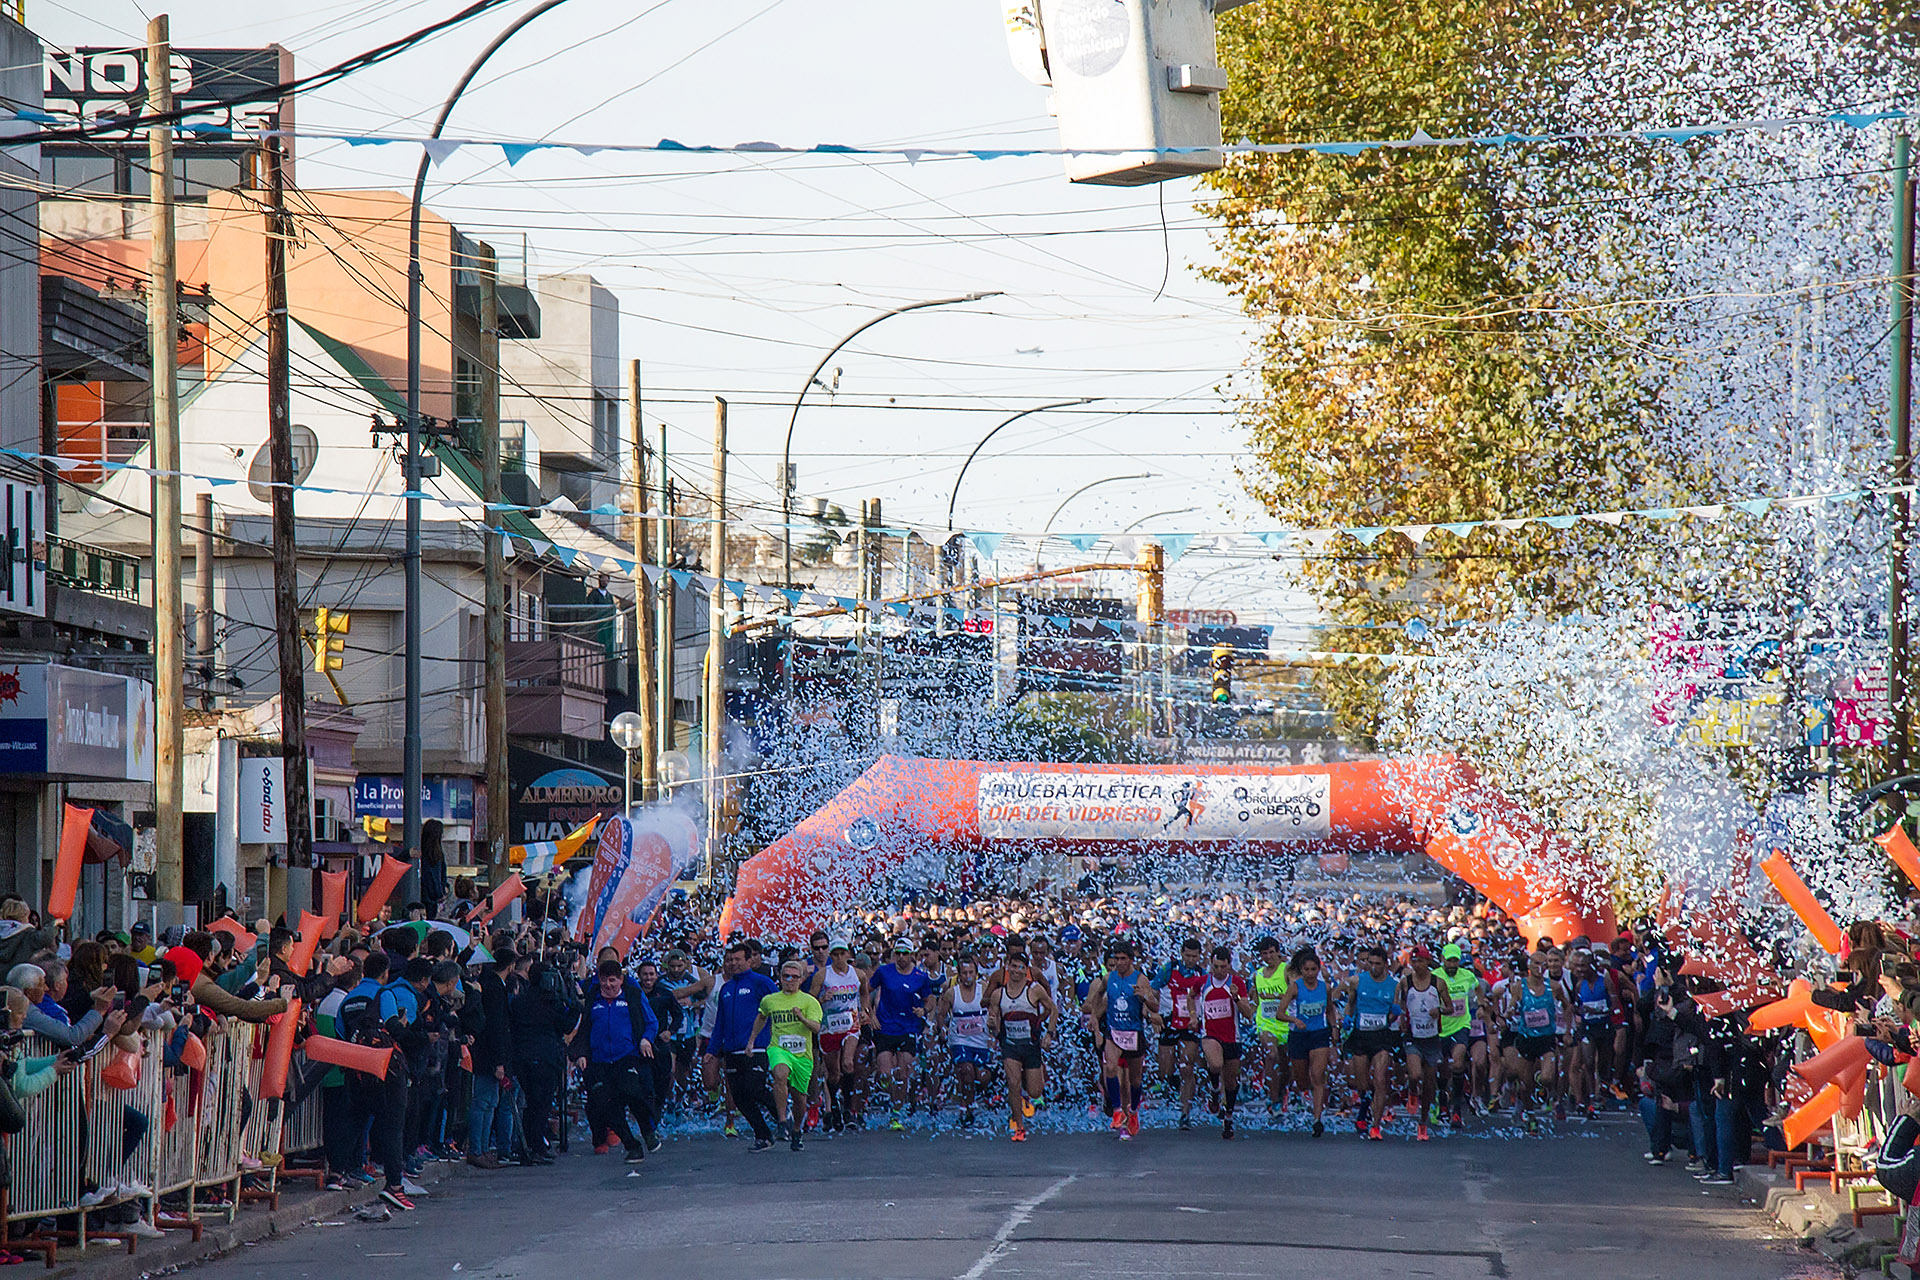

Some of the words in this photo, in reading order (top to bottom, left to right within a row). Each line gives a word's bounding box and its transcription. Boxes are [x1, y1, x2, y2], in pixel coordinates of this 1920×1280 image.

[363, 783, 377, 799] la
[519, 786, 622, 804] ALMENDRO
[260, 766, 274, 834] rapipago
[1254, 806, 1265, 815] de
[1267, 805, 1301, 815] BERA
